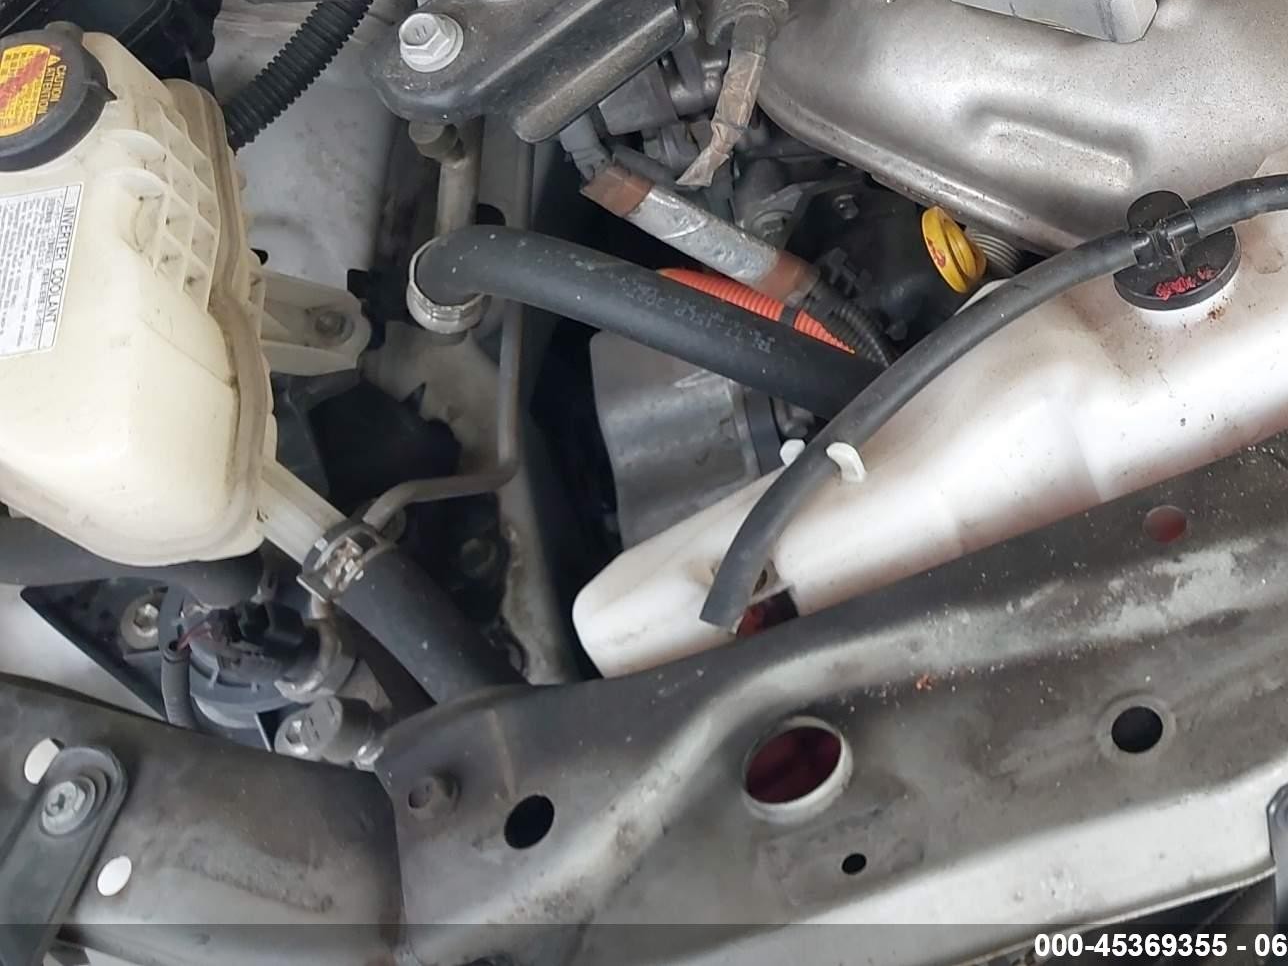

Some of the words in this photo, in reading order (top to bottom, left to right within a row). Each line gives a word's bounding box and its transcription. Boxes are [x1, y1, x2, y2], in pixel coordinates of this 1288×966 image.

[37, 66, 56, 114] ATTENTION
[50, 65, 67, 102] CAUTION
[55, 206, 75, 262] INVERTER
[46, 268, 65, 323] COOLANT
